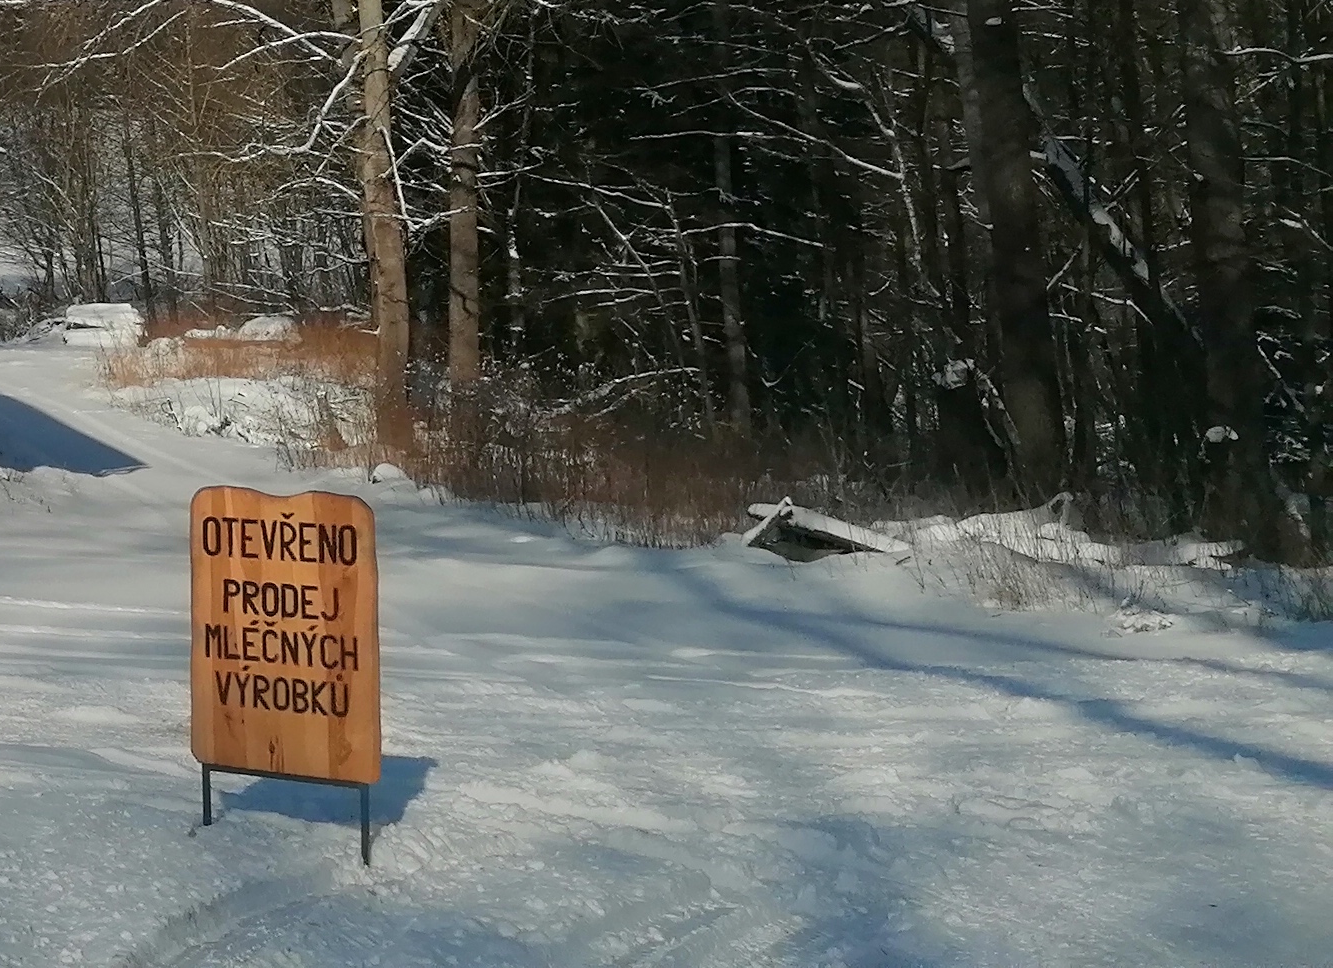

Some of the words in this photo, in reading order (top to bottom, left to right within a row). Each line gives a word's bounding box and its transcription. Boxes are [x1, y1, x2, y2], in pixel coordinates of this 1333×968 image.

[202, 512, 358, 566] OTEVŘENO
[223, 579, 339, 621] PRODEJ
[205, 620, 359, 671] MLÉČNÝCH
[215, 665, 350, 718] VÝROBKŮ
